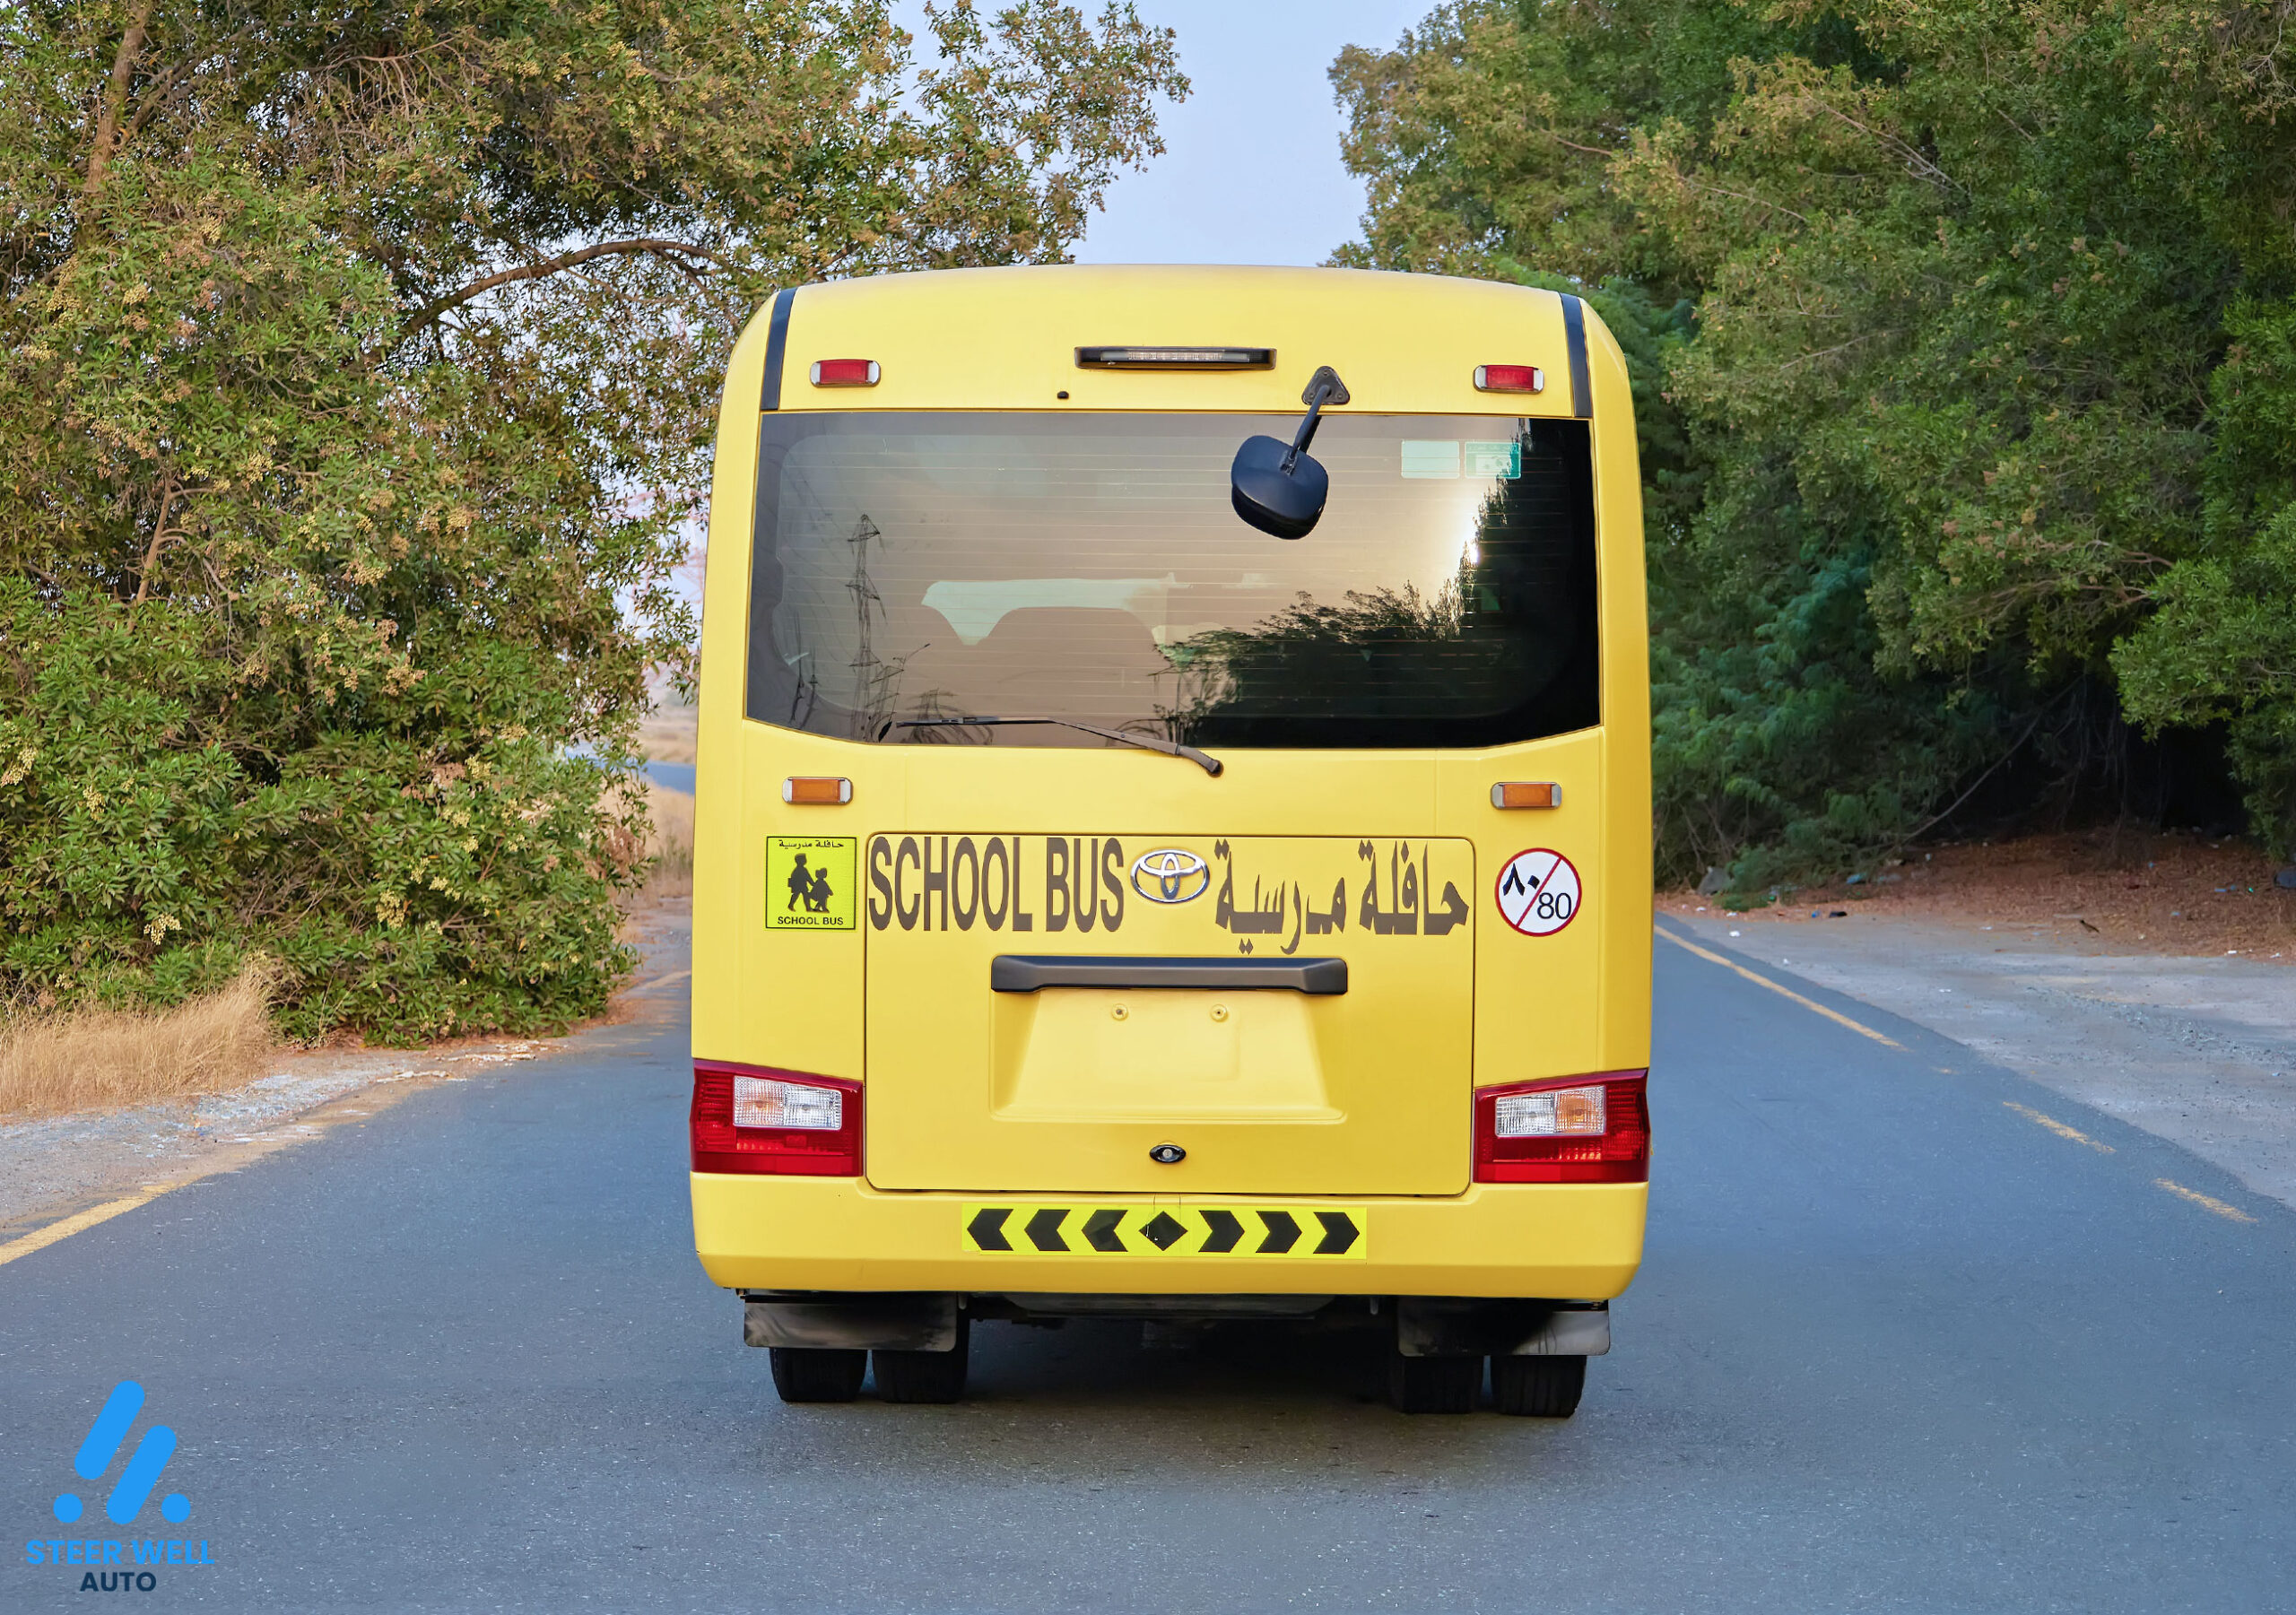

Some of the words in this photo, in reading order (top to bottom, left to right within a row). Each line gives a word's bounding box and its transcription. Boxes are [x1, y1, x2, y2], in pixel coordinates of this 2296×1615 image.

[778, 839, 813, 850] مدرسية
[815, 839, 845, 848] حافلة
[868, 836, 1033, 932] SCHOOL
[1045, 837, 1125, 933] BUS
[1357, 838, 1470, 936] حافلة
[1502, 862, 1541, 897] ٨٠
[1213, 838, 1347, 956] مدرسية
[1536, 892, 1572, 920] 80
[777, 916, 820, 925] SCHOOL
[822, 916, 844, 925] BUS
